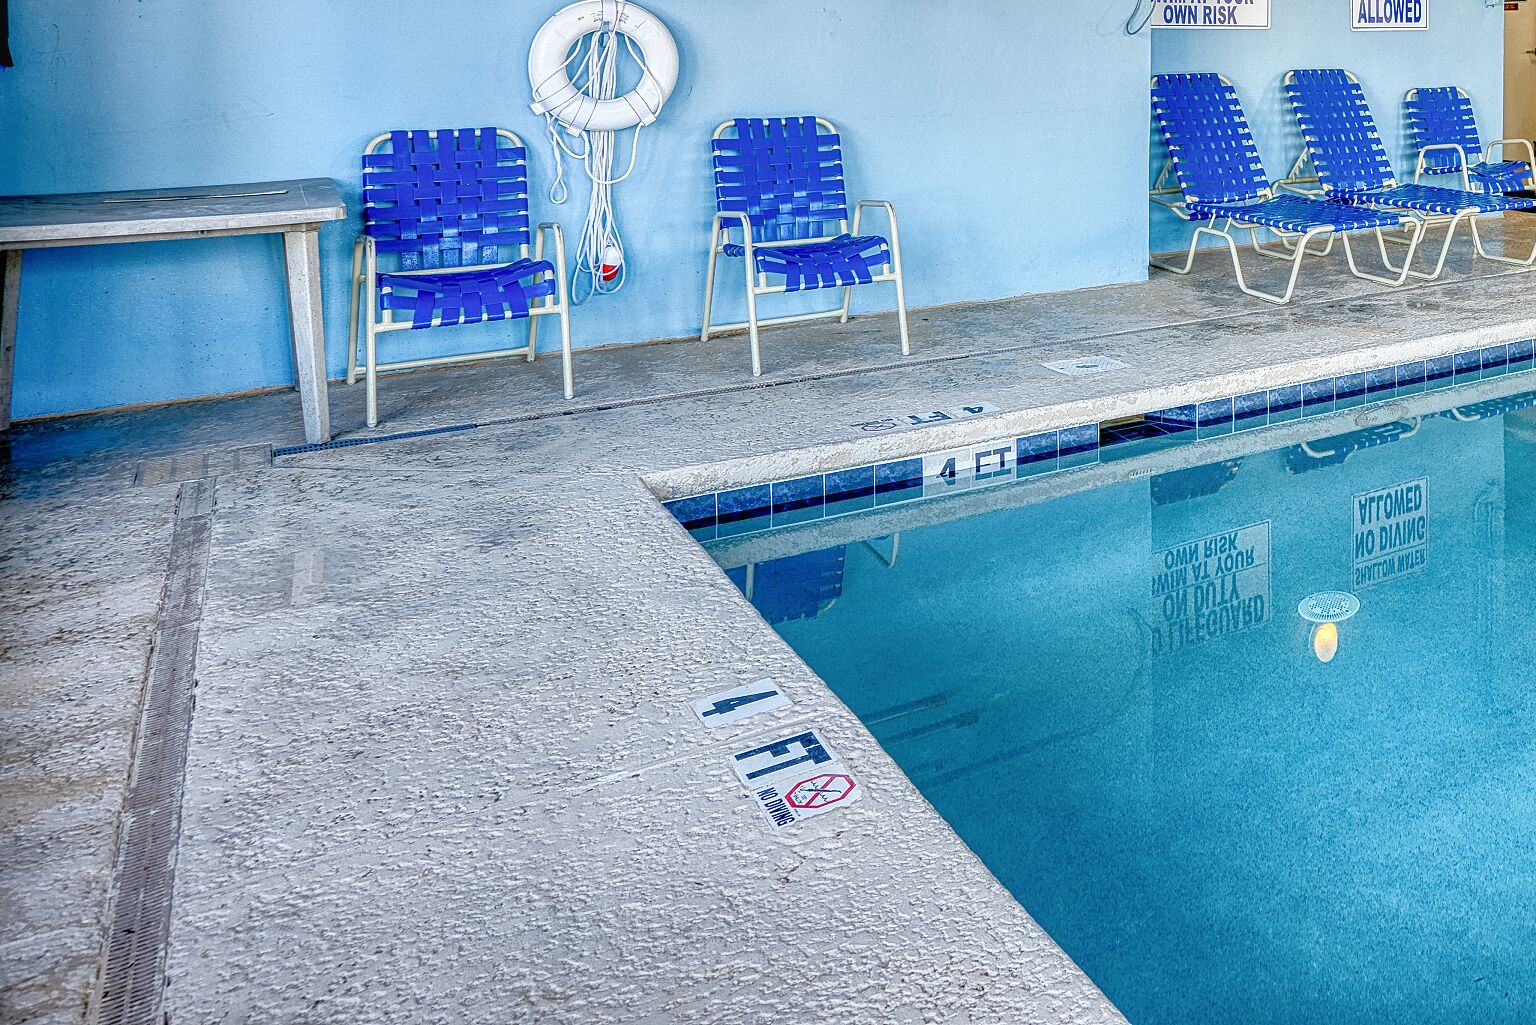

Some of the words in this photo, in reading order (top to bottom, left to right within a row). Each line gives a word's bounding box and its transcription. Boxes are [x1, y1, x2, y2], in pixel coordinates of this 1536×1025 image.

[1163, 5, 1198, 24] OWN
[1203, 6, 1238, 25] RISK
[907, 411, 952, 425] FT
[962, 406, 984, 414] 4
[936, 457, 959, 487] 4
[975, 446, 1012, 481] FT
[702, 690, 779, 718] 4
[734, 731, 833, 780] FT
[757, 787, 779, 801] NO
[764, 798, 795, 827] DIVING
